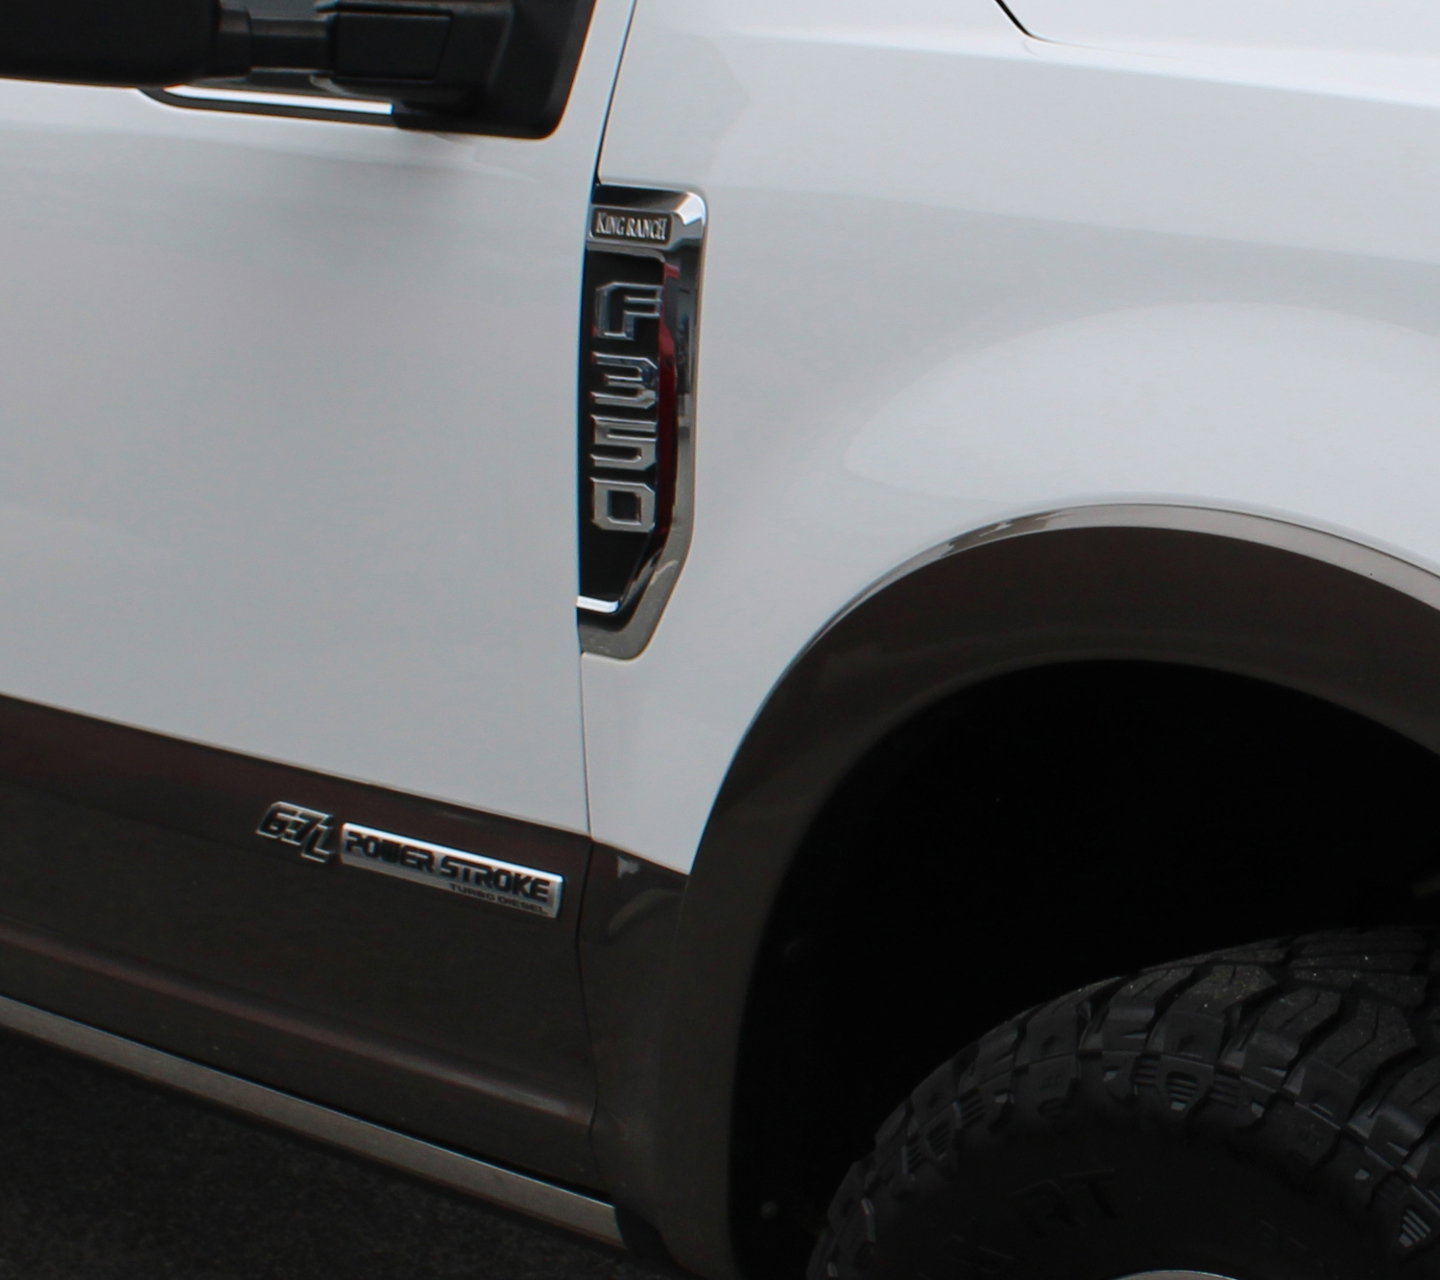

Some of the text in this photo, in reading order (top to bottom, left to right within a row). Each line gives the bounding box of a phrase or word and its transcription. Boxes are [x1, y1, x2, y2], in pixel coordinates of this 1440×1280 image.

[596, 212, 667, 240] KING RANCH
[345, 829, 435, 872] POWER
[440, 855, 550, 903] STROKE
[449, 883, 546, 915] TURBO DIESEL
